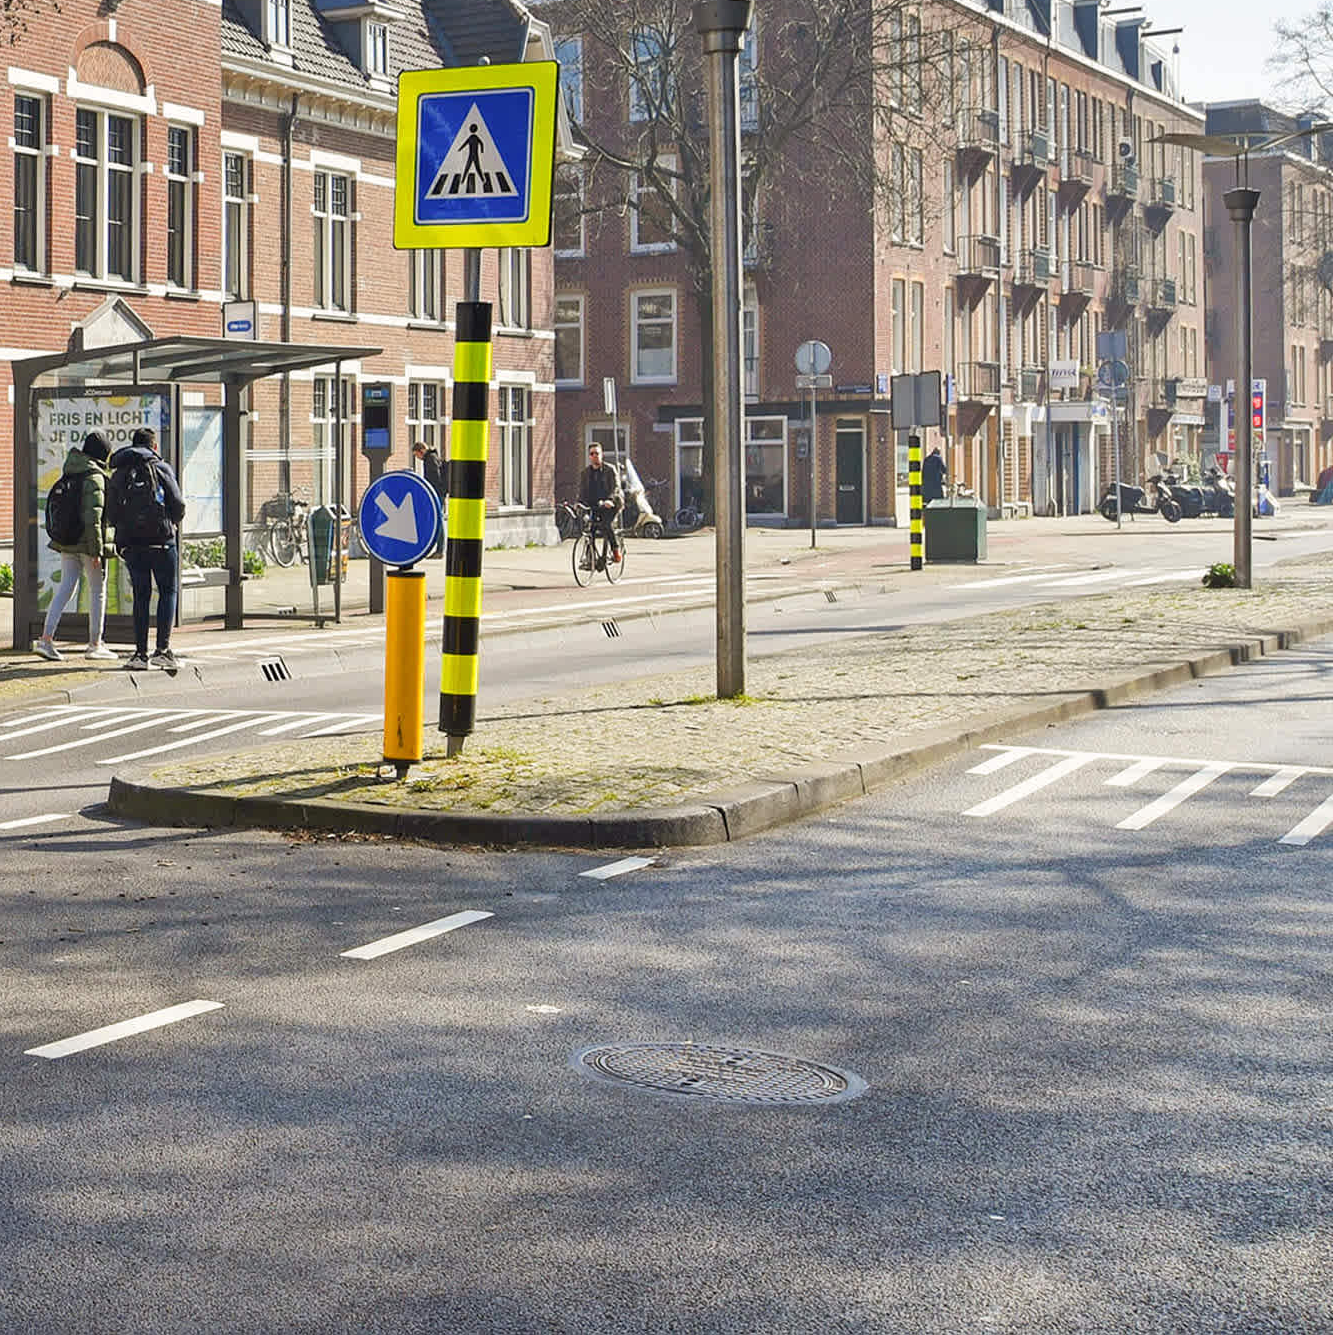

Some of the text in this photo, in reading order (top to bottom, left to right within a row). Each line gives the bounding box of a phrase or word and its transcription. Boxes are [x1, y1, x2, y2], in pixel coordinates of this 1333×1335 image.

[50, 411, 150, 425] FRIS EN LICHT
